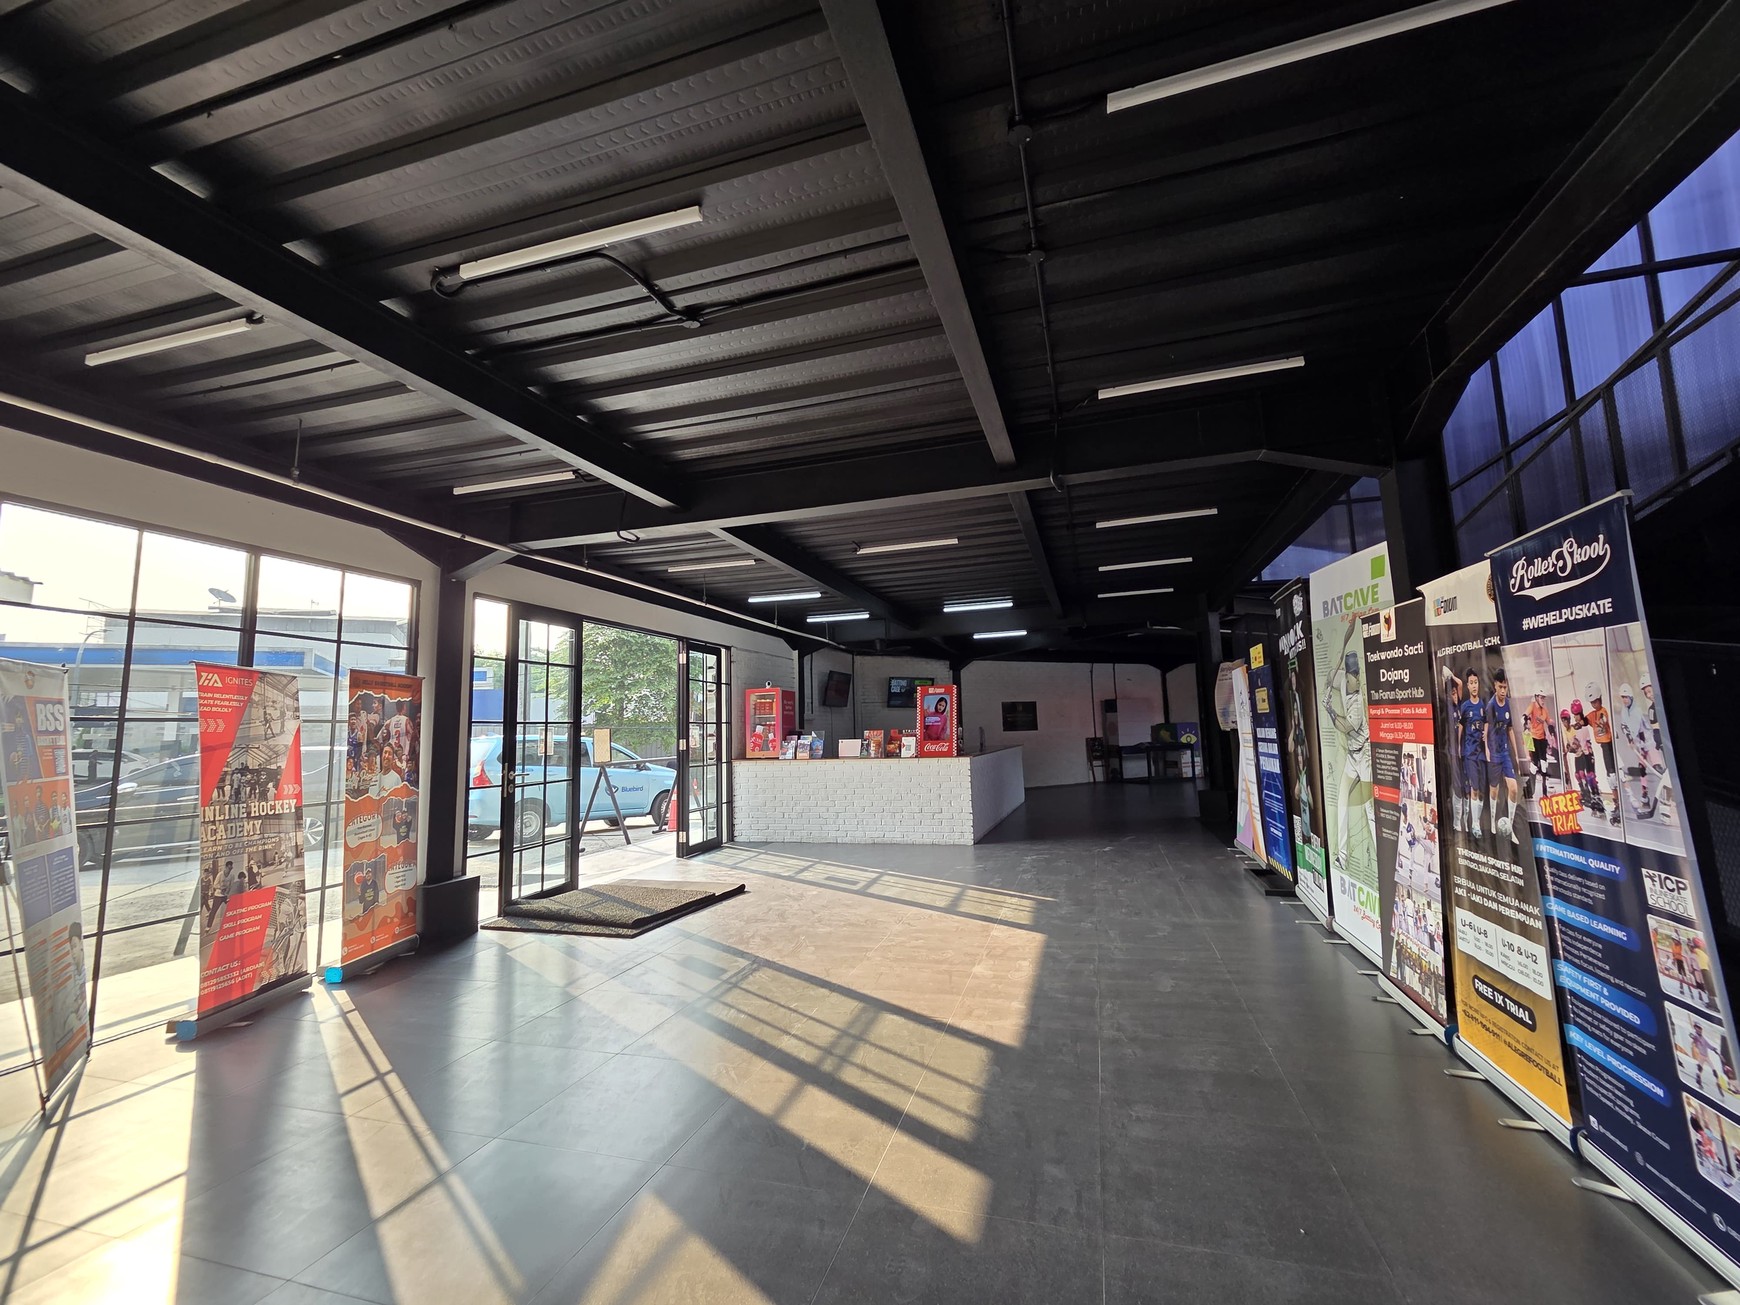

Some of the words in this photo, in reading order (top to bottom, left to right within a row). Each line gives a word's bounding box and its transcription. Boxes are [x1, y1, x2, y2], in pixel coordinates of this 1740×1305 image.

[1322, 582, 1380, 618] BATCAVE
[1522, 597, 1613, 631] #WEHELPUSKATE
[1366, 646, 1404, 663] Taekwondo
[1403, 641, 1424, 656] Sacti
[225, 676, 253, 687] IGNITES
[1379, 667, 1410, 685] Dojang
[1395, 687, 1412, 701] Sport
[1411, 686, 1425, 698] Hub
[35, 703, 65, 732] BSS
[621, 785, 644, 793] Bluebird
[200, 803, 247, 822] INLINE
[250, 798, 298, 817] HOCKEY
[1540, 797, 1552, 816] 1X
[1551, 792, 1581, 813] FREE
[200, 819, 263, 842] ACADEMY
[1552, 813, 1580, 833] TRIAL
[243, 836, 280, 848] CHAMPIONS
[245, 845, 257, 853] THE
[1487, 856, 1511, 872] SPORTS
[1535, 844, 1588, 865] INTERNATIONAL
[1587, 858, 1621, 875] QUALITY
[1657, 873, 1689, 896] ICP
[1483, 897, 1499, 911] DAN
[1498, 903, 1543, 930] PEREMPUAN
[1650, 893, 1695, 918] SCHOOL
[1460, 918, 1473, 930] U-6
[1566, 907, 1590, 924] BASED
[1589, 918, 1628, 941] LEARNING
[1516, 945, 1524, 956] &
[1556, 963, 1583, 981] SAFETY
[1582, 976, 1603, 992] FIRST
[1602, 987, 1610, 996] &
[1474, 978, 1494, 1000] FREE
[1493, 991, 1505, 1007] 1X
[1504, 998, 1533, 1025] TRIAL
[1599, 996, 1641, 1025] PROVIDED
[1584, 1040, 1607, 1060] LEVEL
[1606, 1053, 1665, 1098] PROGRESSION
